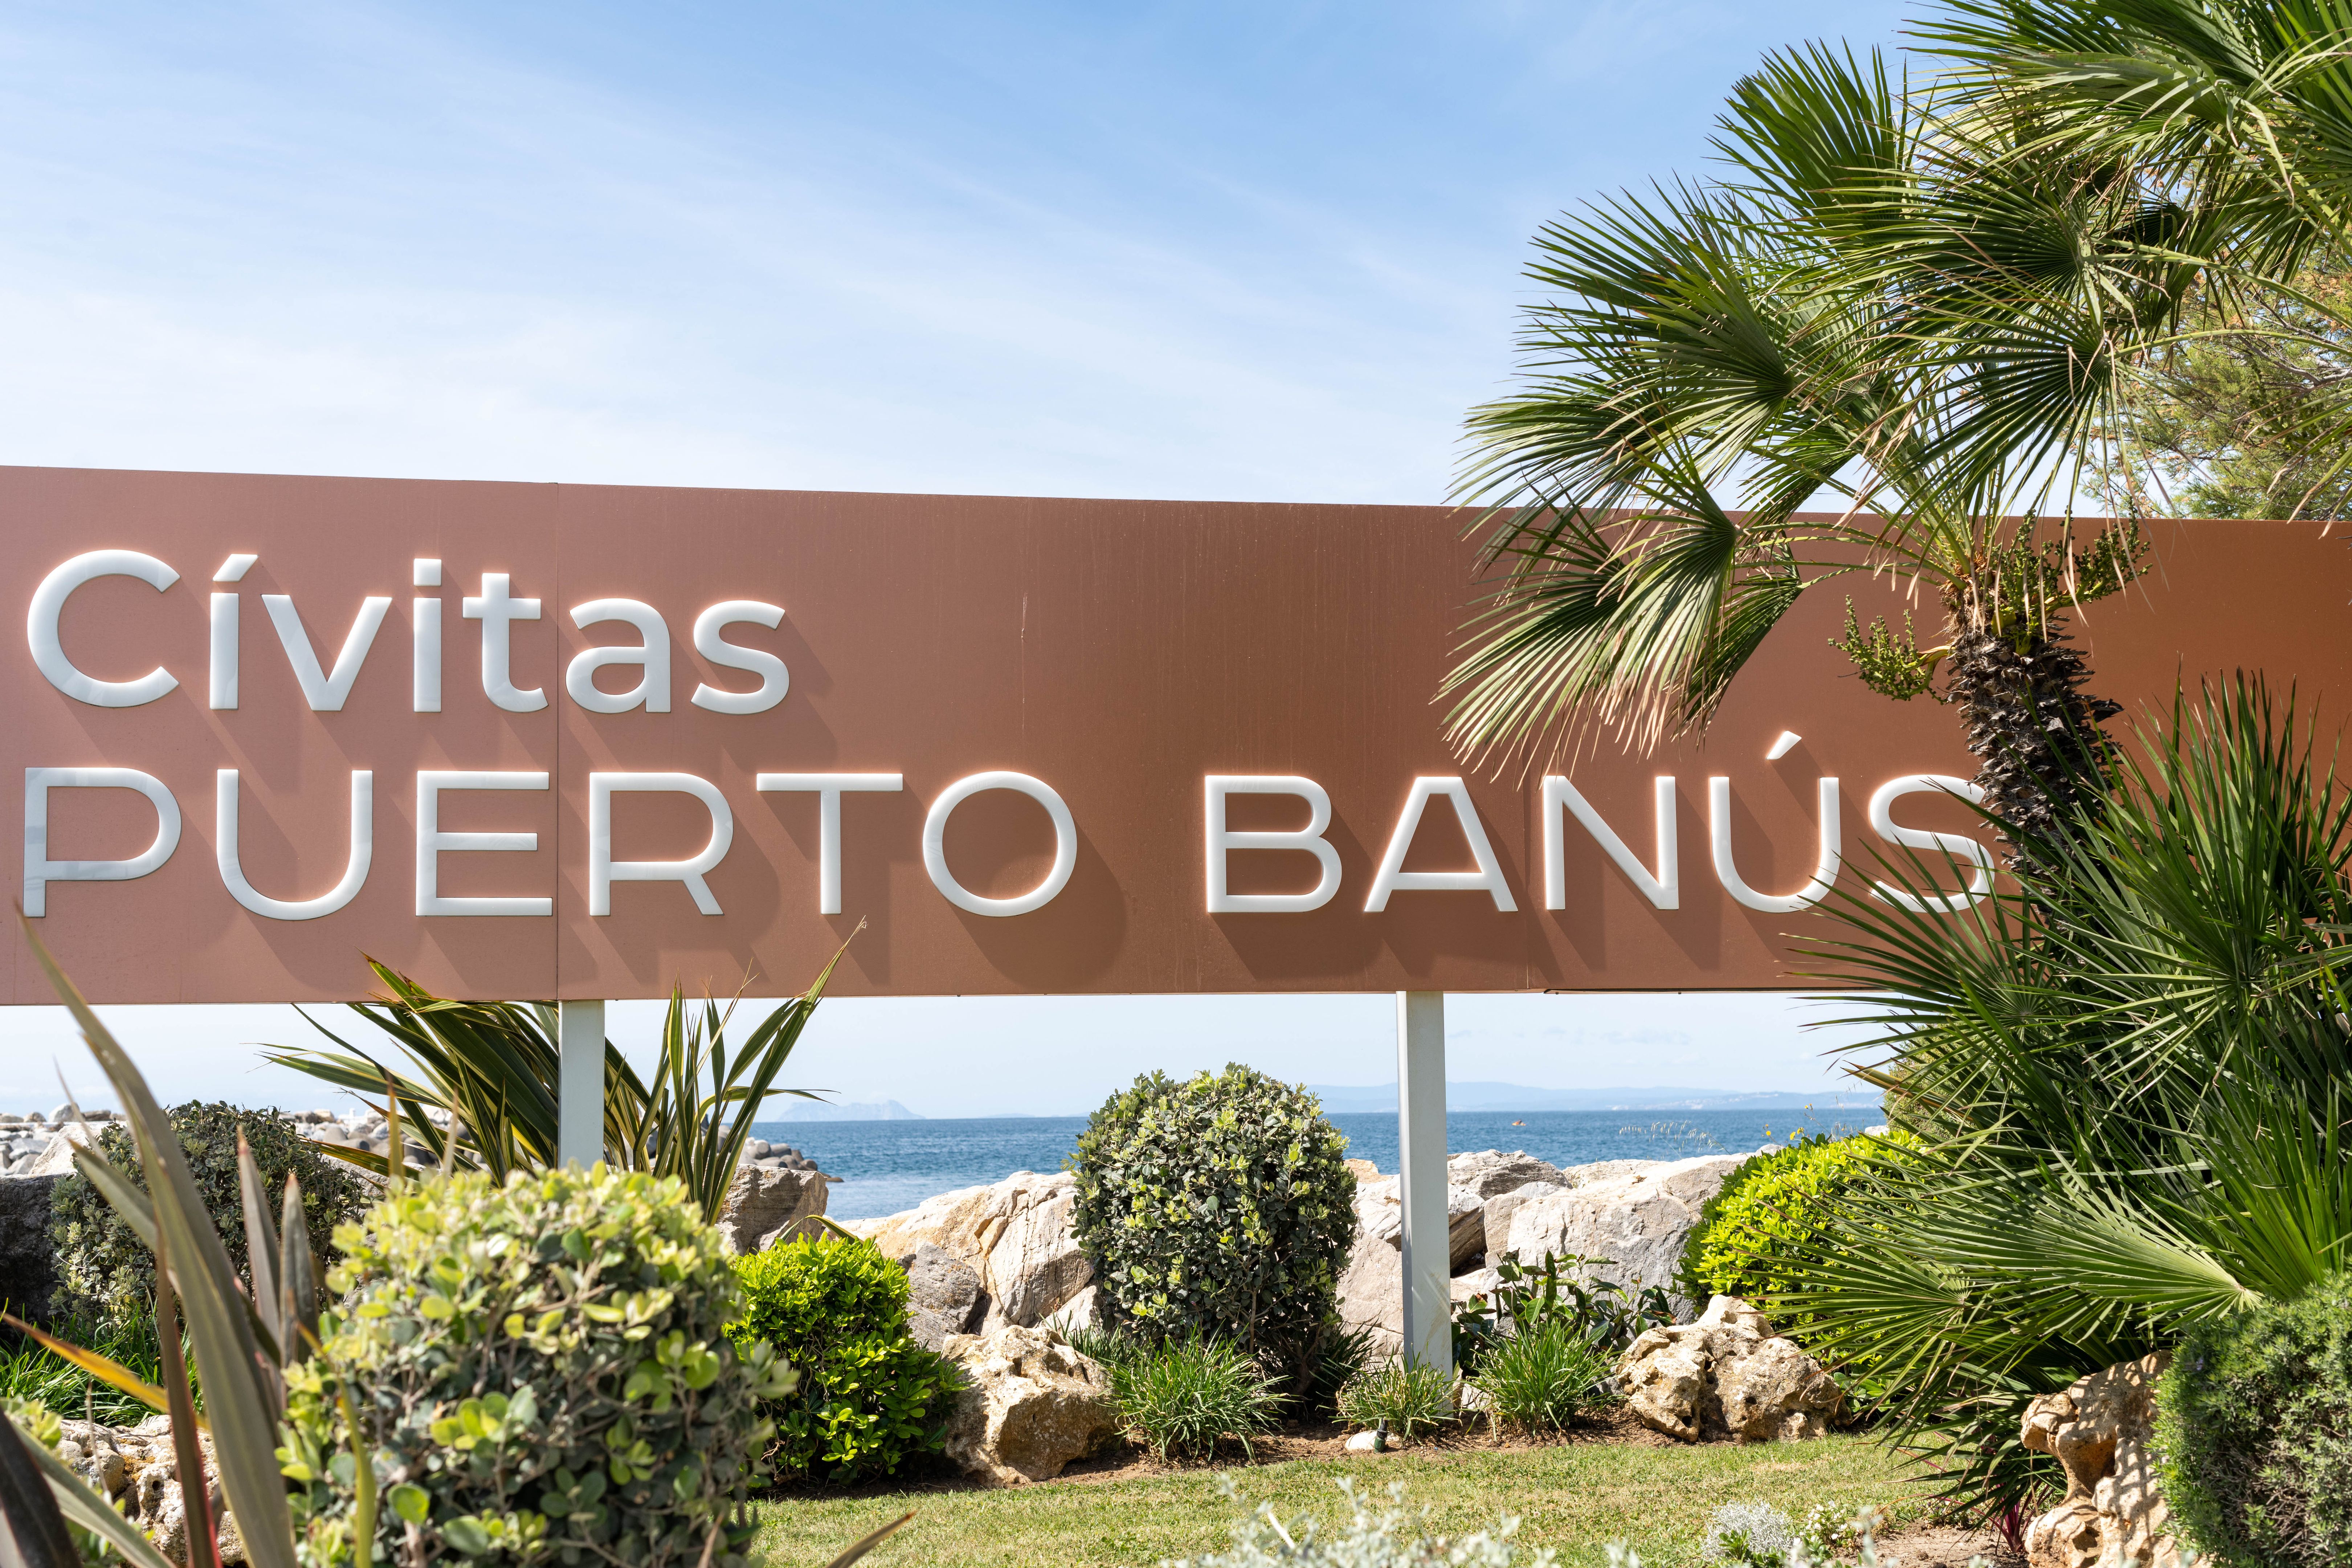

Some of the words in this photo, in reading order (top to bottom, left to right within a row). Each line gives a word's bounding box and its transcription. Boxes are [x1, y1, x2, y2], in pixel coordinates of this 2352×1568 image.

[27, 549, 790, 714] Cívitas
[23, 766, 1077, 920] PUERTO
[1205, 730, 1995, 913] BANÚS
